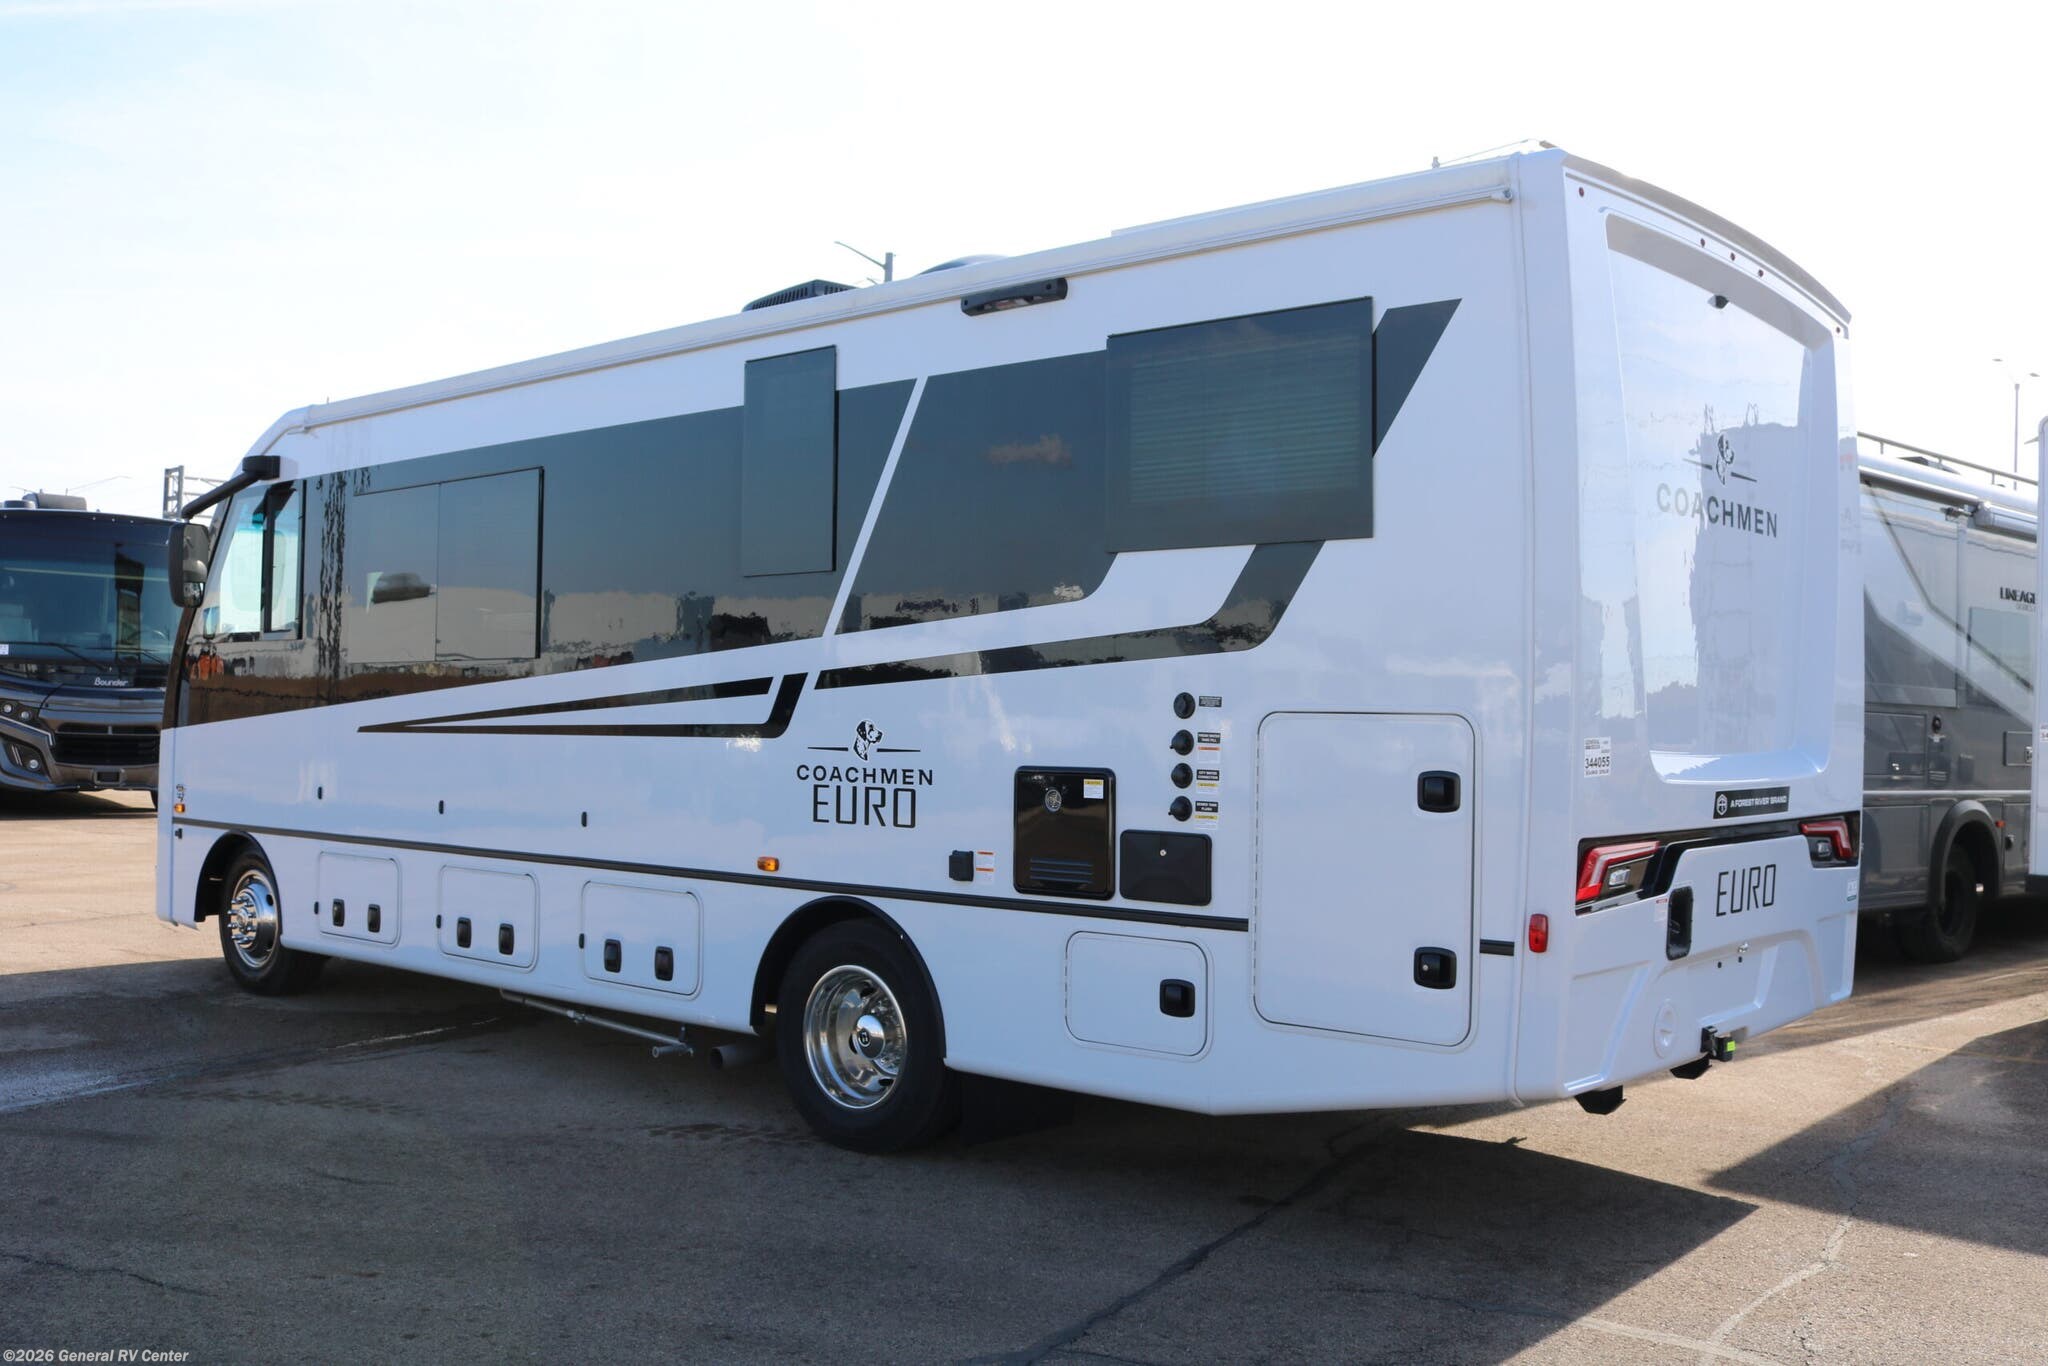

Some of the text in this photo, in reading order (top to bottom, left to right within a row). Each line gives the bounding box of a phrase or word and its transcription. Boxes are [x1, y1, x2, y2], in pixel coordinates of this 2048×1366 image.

[1657, 483, 1777, 538] COACHMEN
[796, 764, 933, 786] COACHMEN
[1585, 756, 1610, 769] 344055
[813, 784, 917, 829] EURO
[1730, 795, 1787, 808] A FOREST RIVER BRAND
[1716, 864, 1776, 917] EURO
